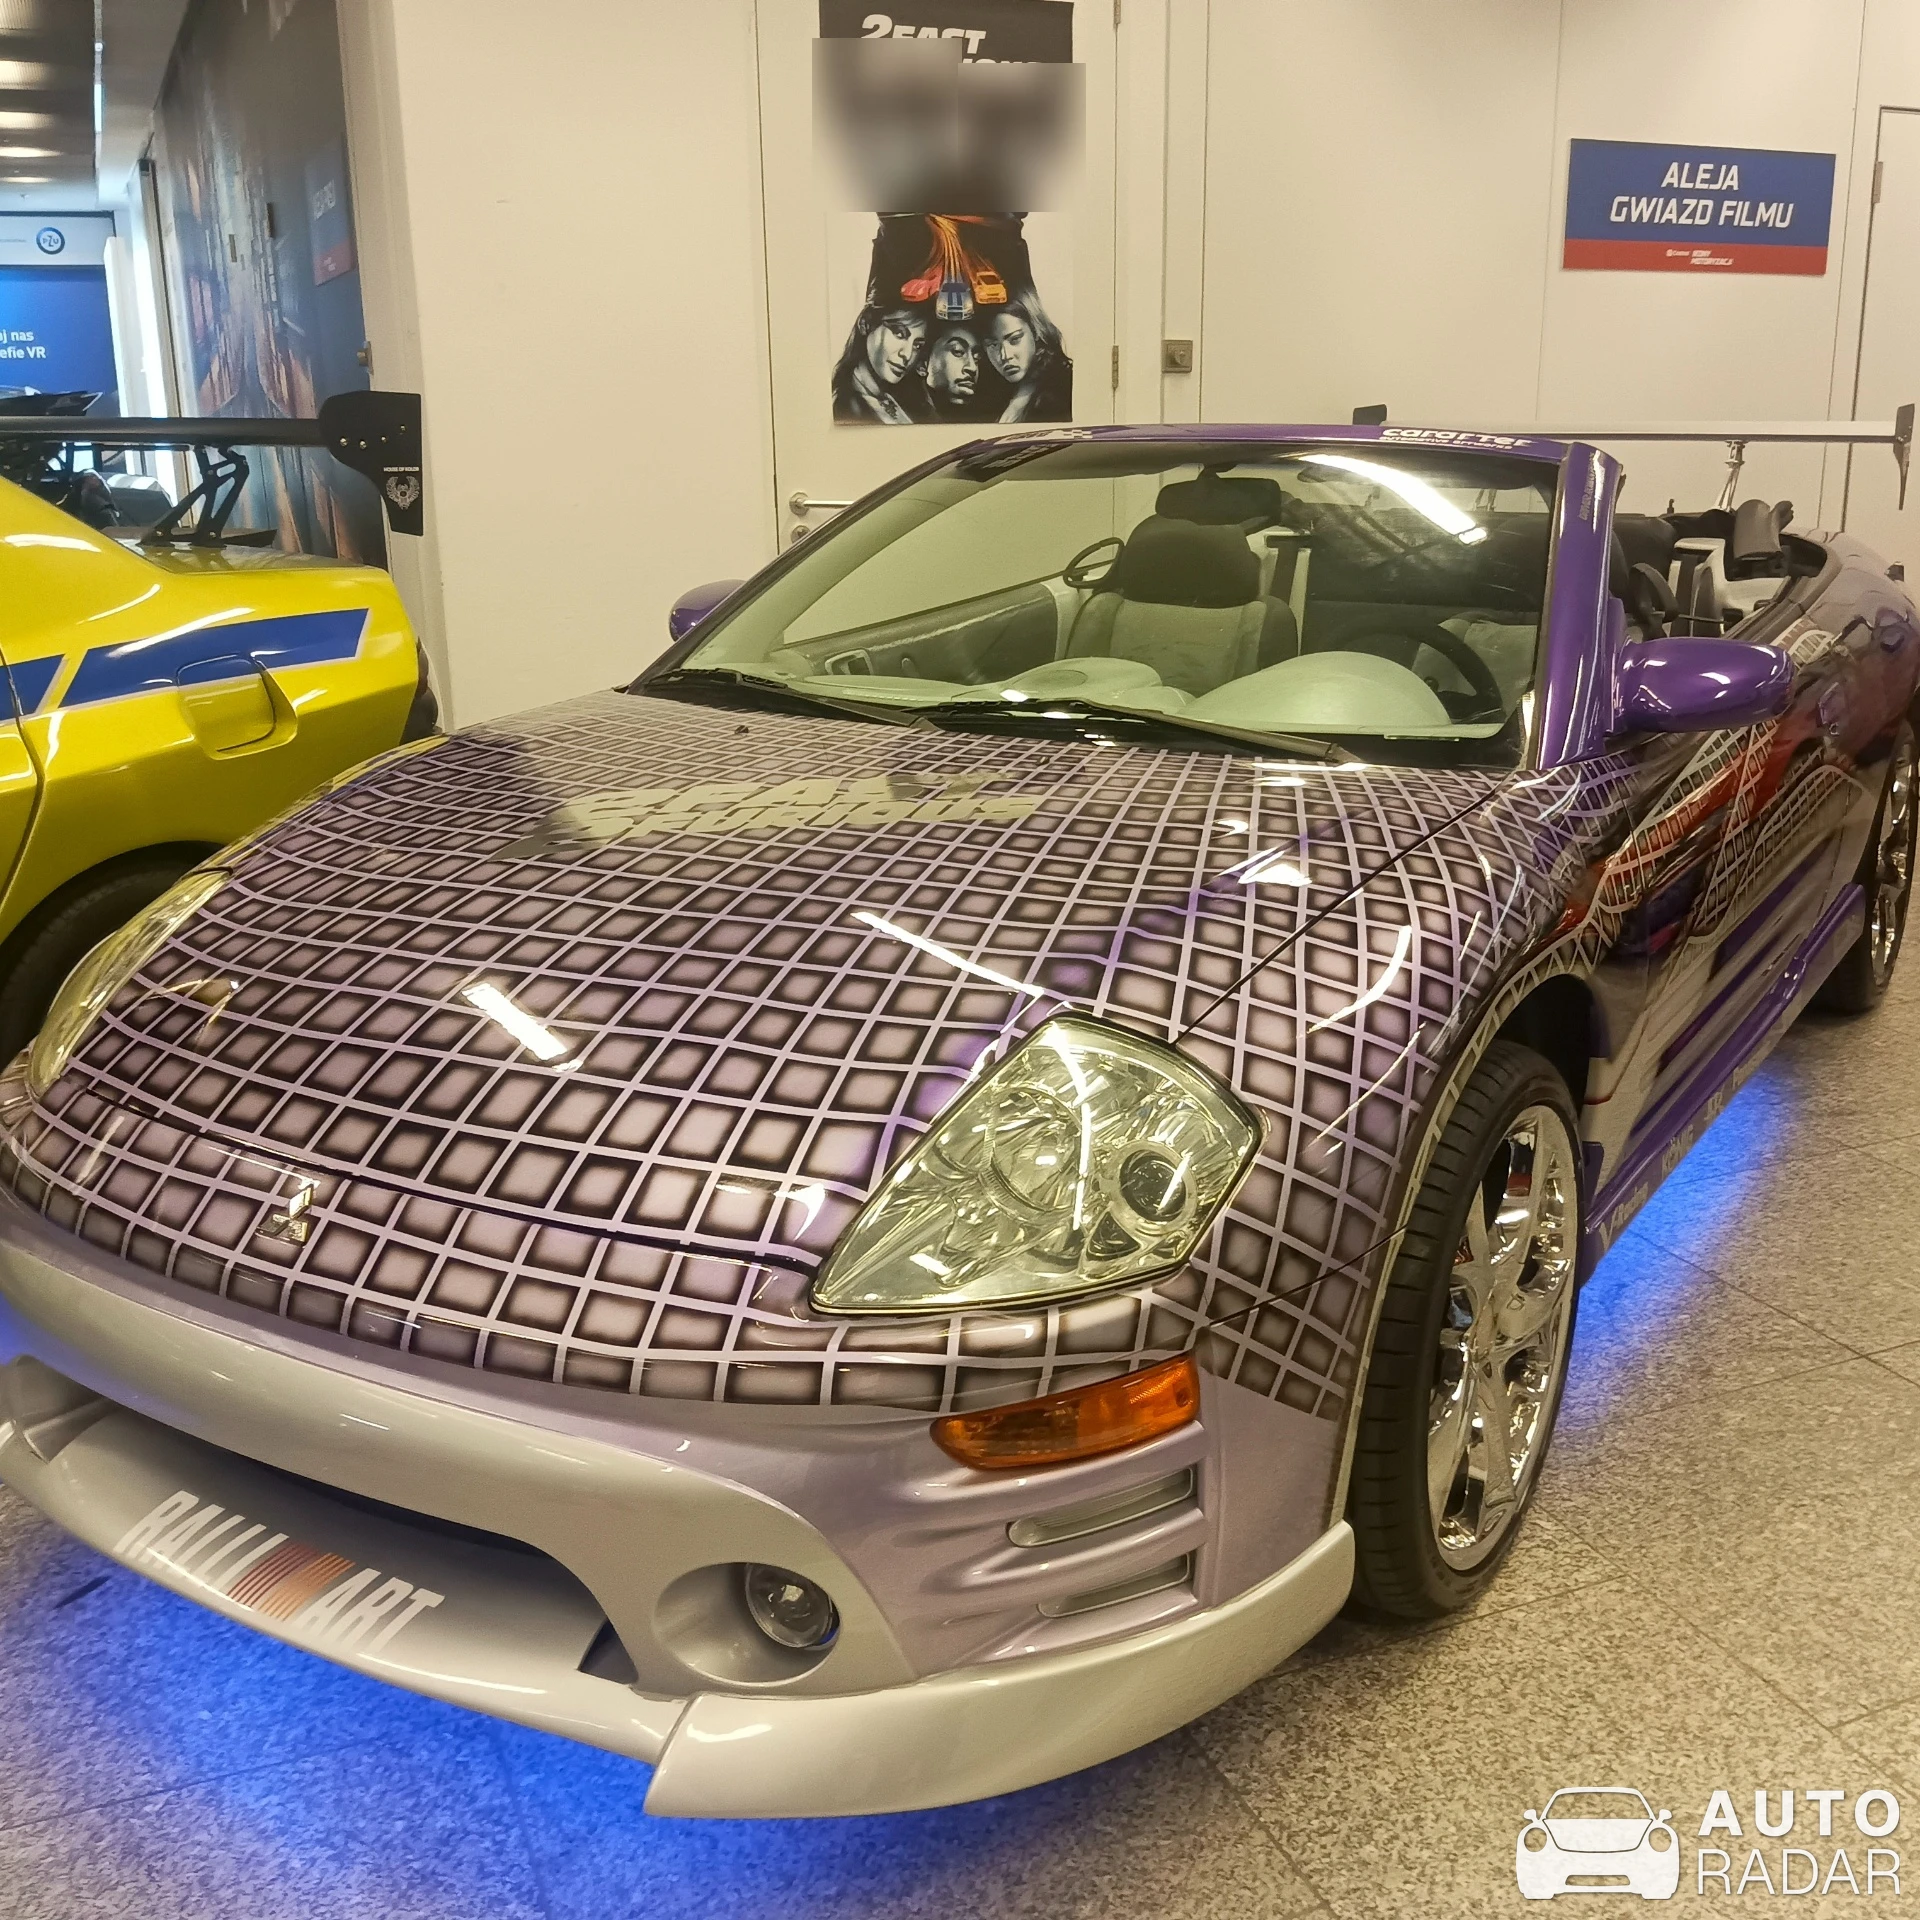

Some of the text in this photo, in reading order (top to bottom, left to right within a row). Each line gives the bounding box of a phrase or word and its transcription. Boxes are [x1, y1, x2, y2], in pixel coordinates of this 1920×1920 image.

[1661, 161, 1739, 191] ALEJA
[1610, 195, 1794, 229] GWIAZD FILMU
[10, 331, 35, 342] nas
[26, 345, 47, 359] VR
[113, 1490, 446, 1652] RALLI ART
